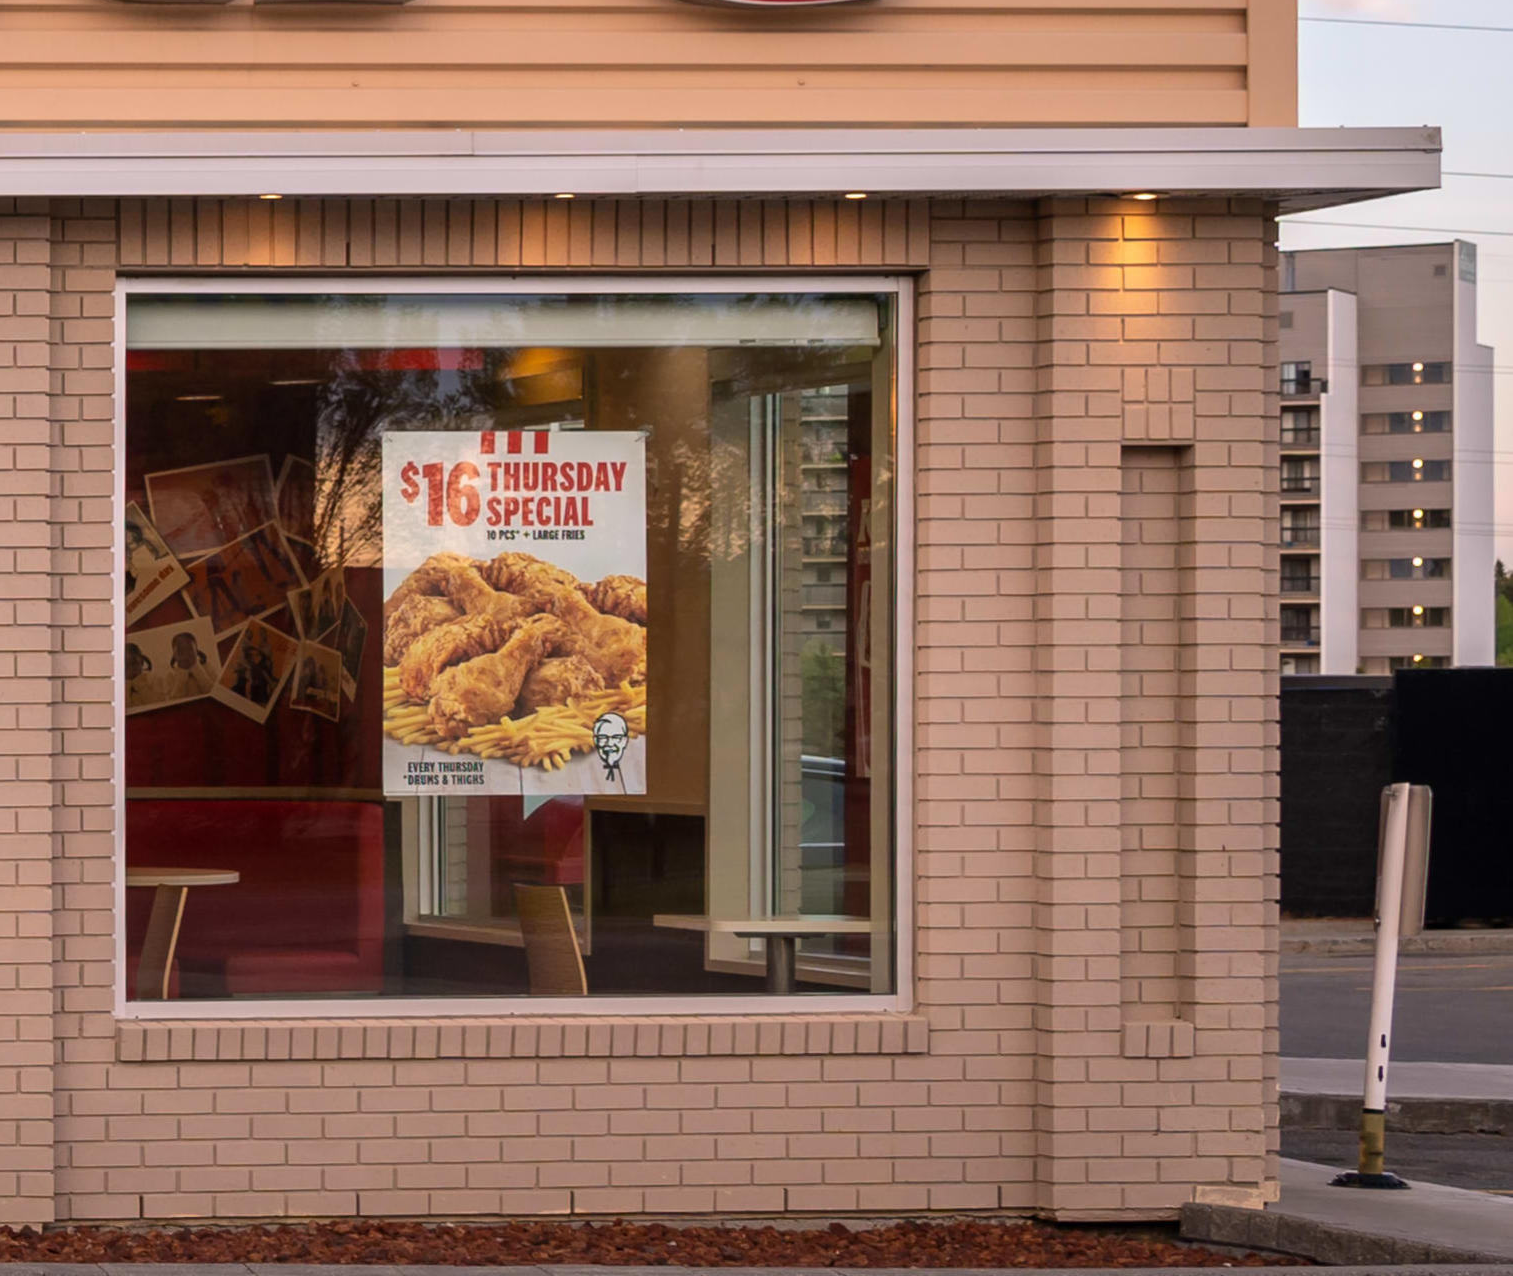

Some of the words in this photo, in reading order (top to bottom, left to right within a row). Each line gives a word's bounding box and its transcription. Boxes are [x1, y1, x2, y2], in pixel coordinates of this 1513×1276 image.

[400, 461, 481, 527] $16
[486, 462, 627, 492] THURSDAY
[486, 496, 594, 527] SPECIAL
[486, 530, 496, 541] 10
[532, 530, 559, 540] LARGE
[561, 530, 586, 540] FRIES
[407, 762, 435, 773] EVERY
[438, 762, 484, 773] THURSDAY
[442, 774, 448, 785] &
[451, 774, 485, 785] THIGHS
